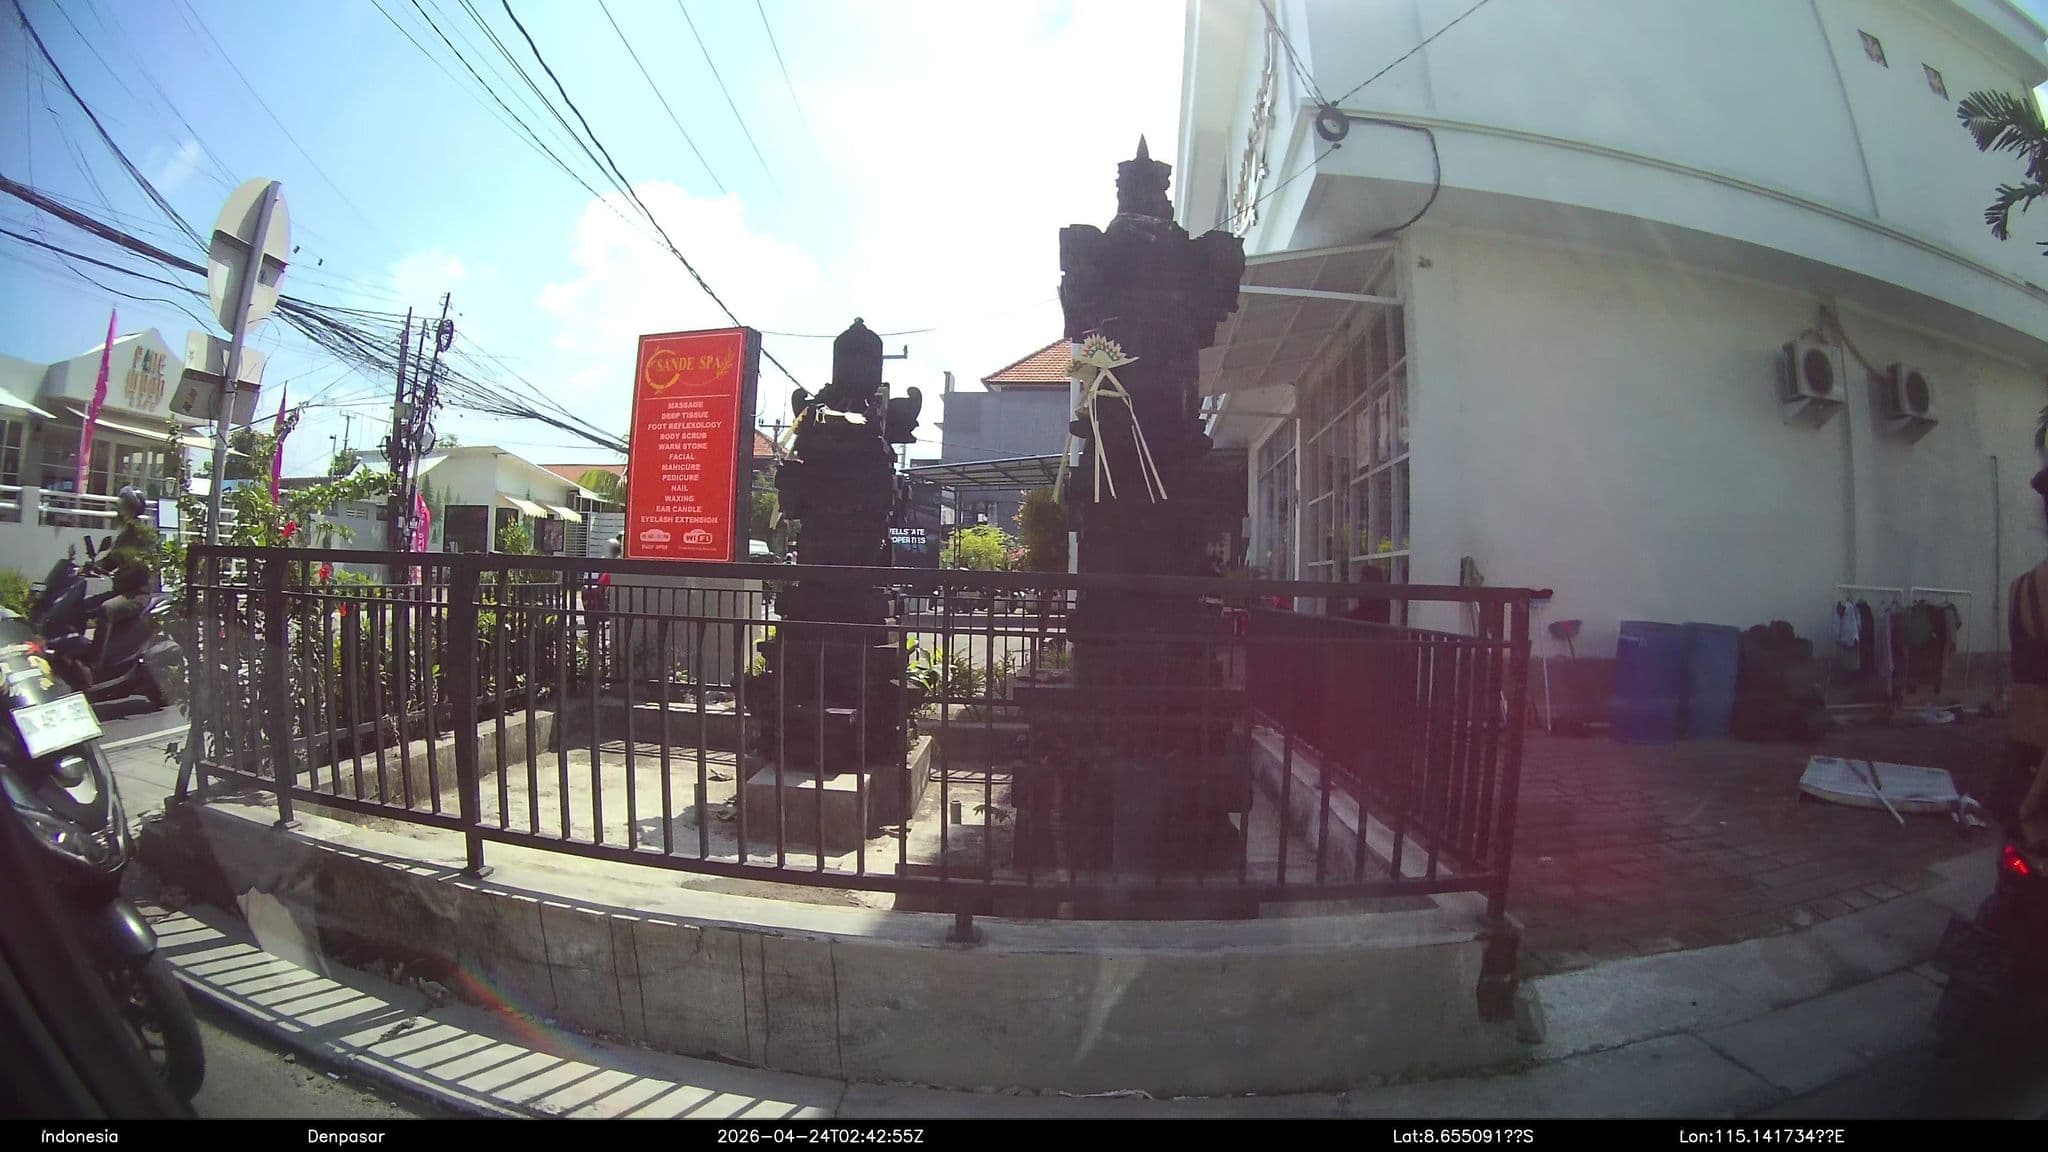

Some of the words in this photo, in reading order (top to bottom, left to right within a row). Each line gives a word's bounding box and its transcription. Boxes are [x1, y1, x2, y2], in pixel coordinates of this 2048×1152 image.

[656, 356, 694, 372] SANDE
[699, 355, 721, 369] SPA
[668, 401, 704, 409] MASSAGE
[682, 411, 709, 419] TISSUE
[668, 421, 722, 430] REFLEXOLOGY
[682, 432, 707, 440] SCRUB
[682, 442, 708, 450] STONE
[640, 515, 673, 523] EYELASH
[674, 516, 718, 524] EXTENSION
